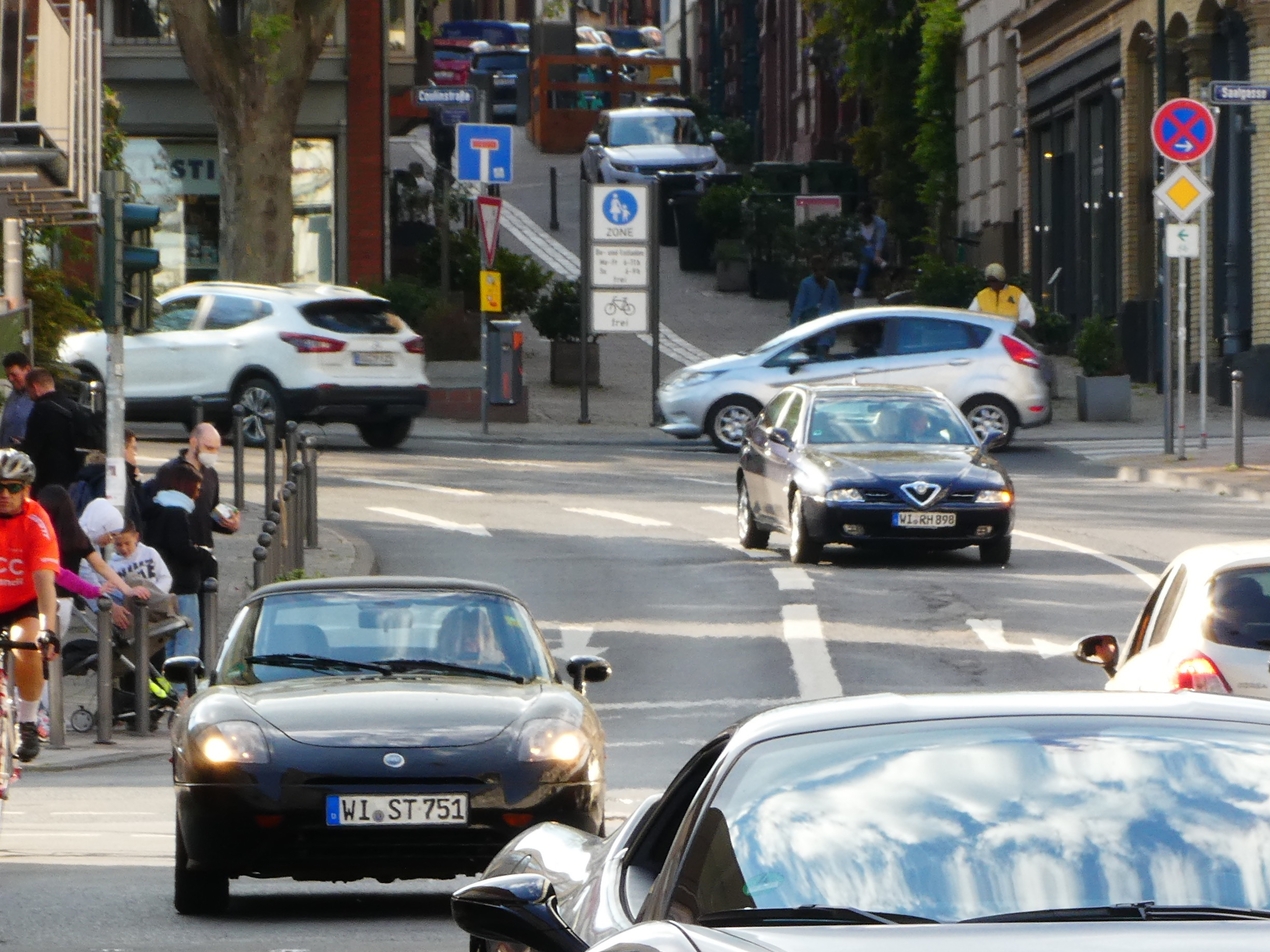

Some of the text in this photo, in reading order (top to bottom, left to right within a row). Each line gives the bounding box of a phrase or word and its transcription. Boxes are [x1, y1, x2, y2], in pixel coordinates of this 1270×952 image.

[1221, 86, 1267, 100] Saalgasse
[606, 228, 633, 237] ZONE
[611, 318, 629, 327] frei
[342, 799, 370, 821] WI
[388, 798, 417, 820] ST
[423, 798, 464, 820] 751
